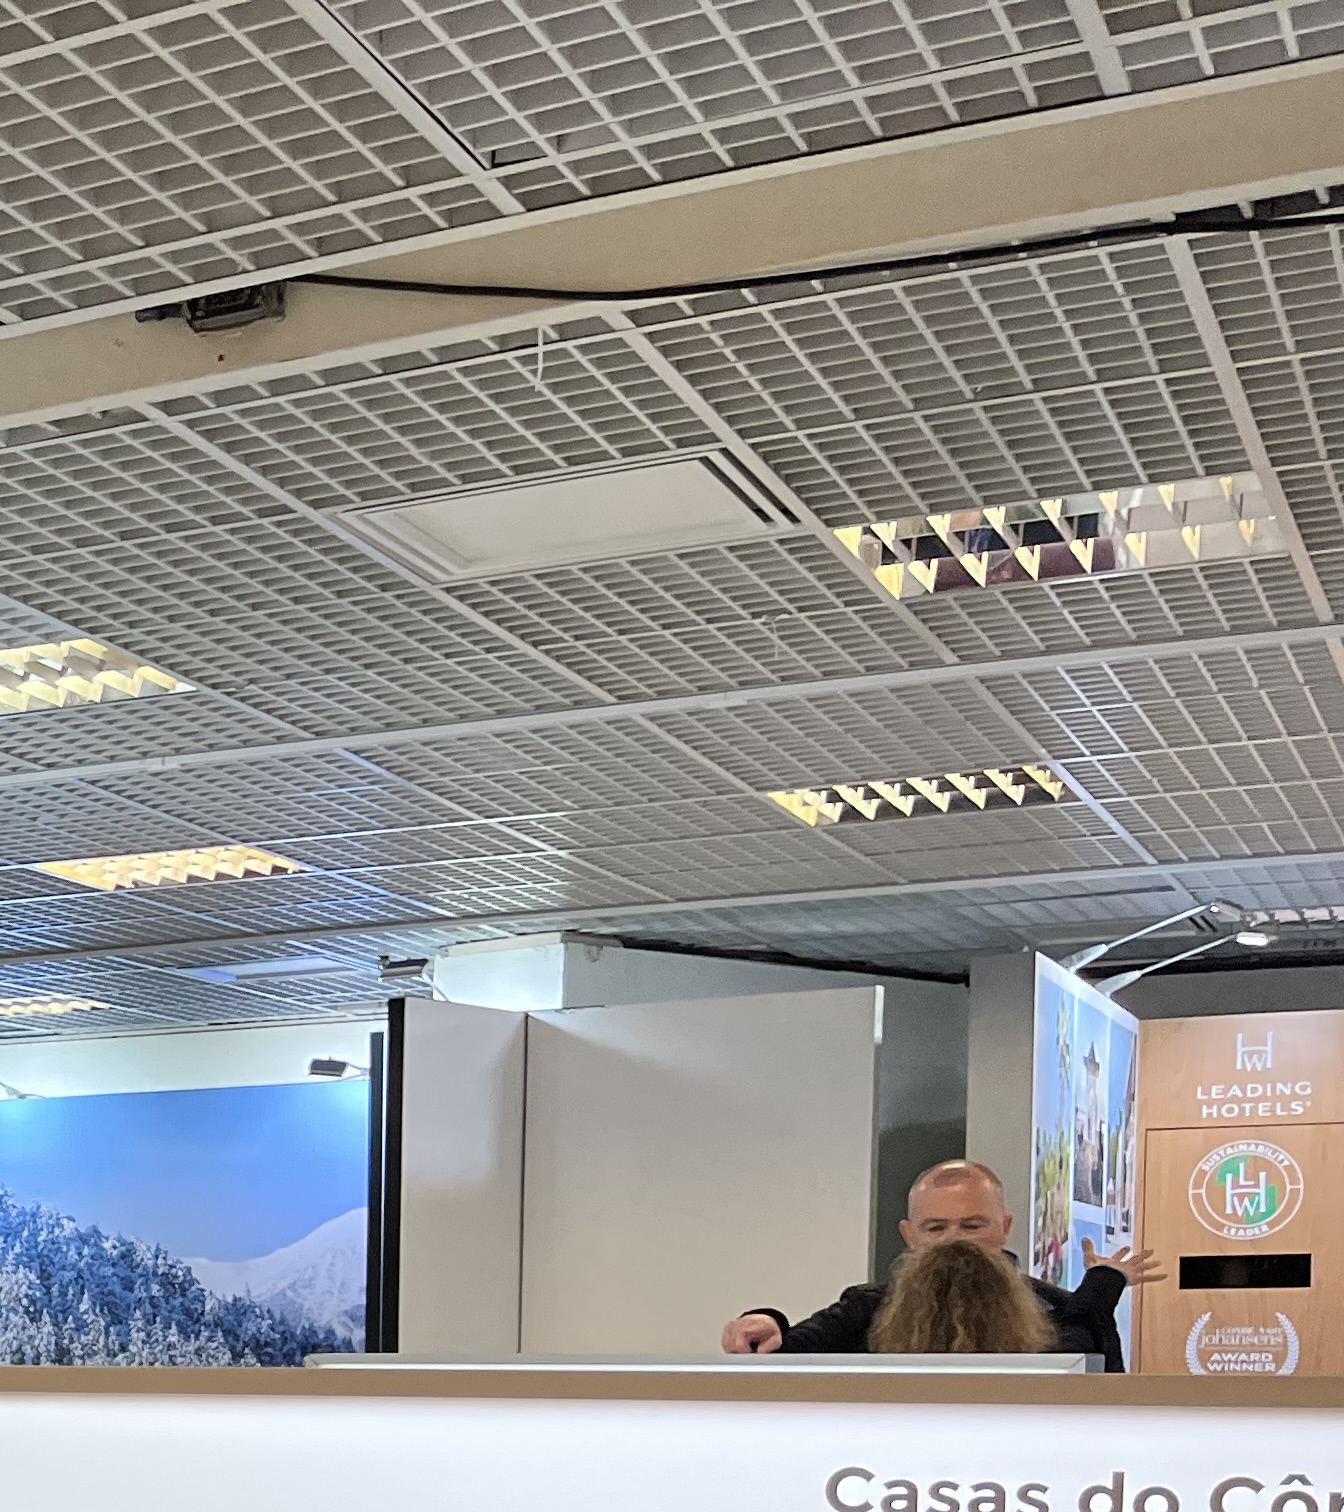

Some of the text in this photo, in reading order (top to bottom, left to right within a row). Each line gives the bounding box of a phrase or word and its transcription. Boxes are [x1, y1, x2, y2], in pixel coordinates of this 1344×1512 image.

[1196, 1081, 1312, 1100] LEADING
[1200, 1143, 1292, 1173] SUSTAINABILITY
[1223, 1224, 1270, 1237] LEADER
[1210, 1352, 1273, 1362] AWARD
[1207, 1362, 1276, 1372] WINNER
